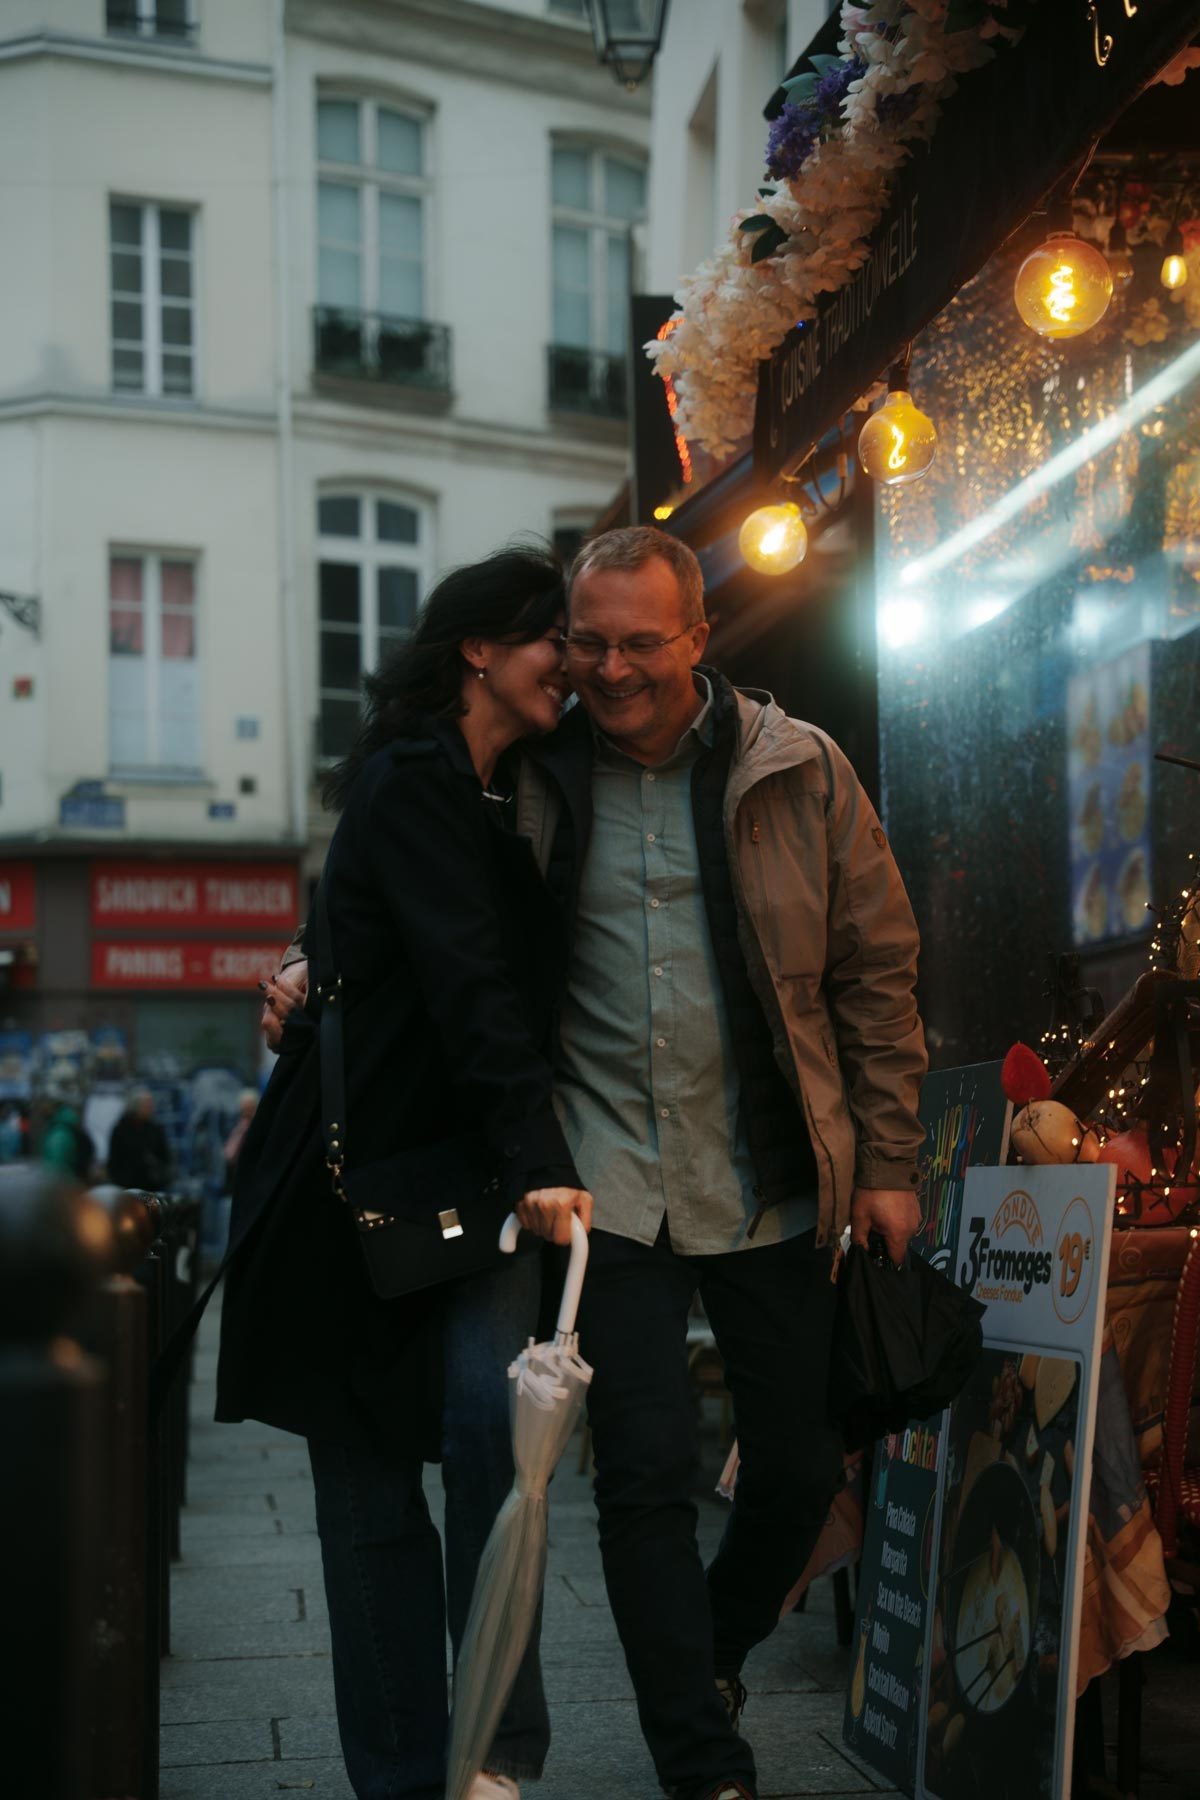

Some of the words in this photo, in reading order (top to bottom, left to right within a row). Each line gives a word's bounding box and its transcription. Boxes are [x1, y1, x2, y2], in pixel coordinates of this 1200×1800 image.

[97, 877, 197, 913] SANDWICH
[932, 1103, 980, 1182] HAPPY
[992, 1197, 1042, 1248] FONDUE
[960, 1216, 986, 1294] 3
[977, 1237, 1053, 1295] Fromages
[897, 1505, 916, 1537] Colada
[880, 1539, 908, 1576] Margarita
[877, 1581, 888, 1610] Sex
[887, 1589, 896, 1613] on
[895, 1589, 905, 1618] the
[903, 1592, 921, 1628] Beach
[873, 1620, 890, 1654] Mojito
[868, 1661, 889, 1699] Cocktail
[888, 1672, 909, 1712] Maison
[880, 1713, 898, 1750] Spritz
